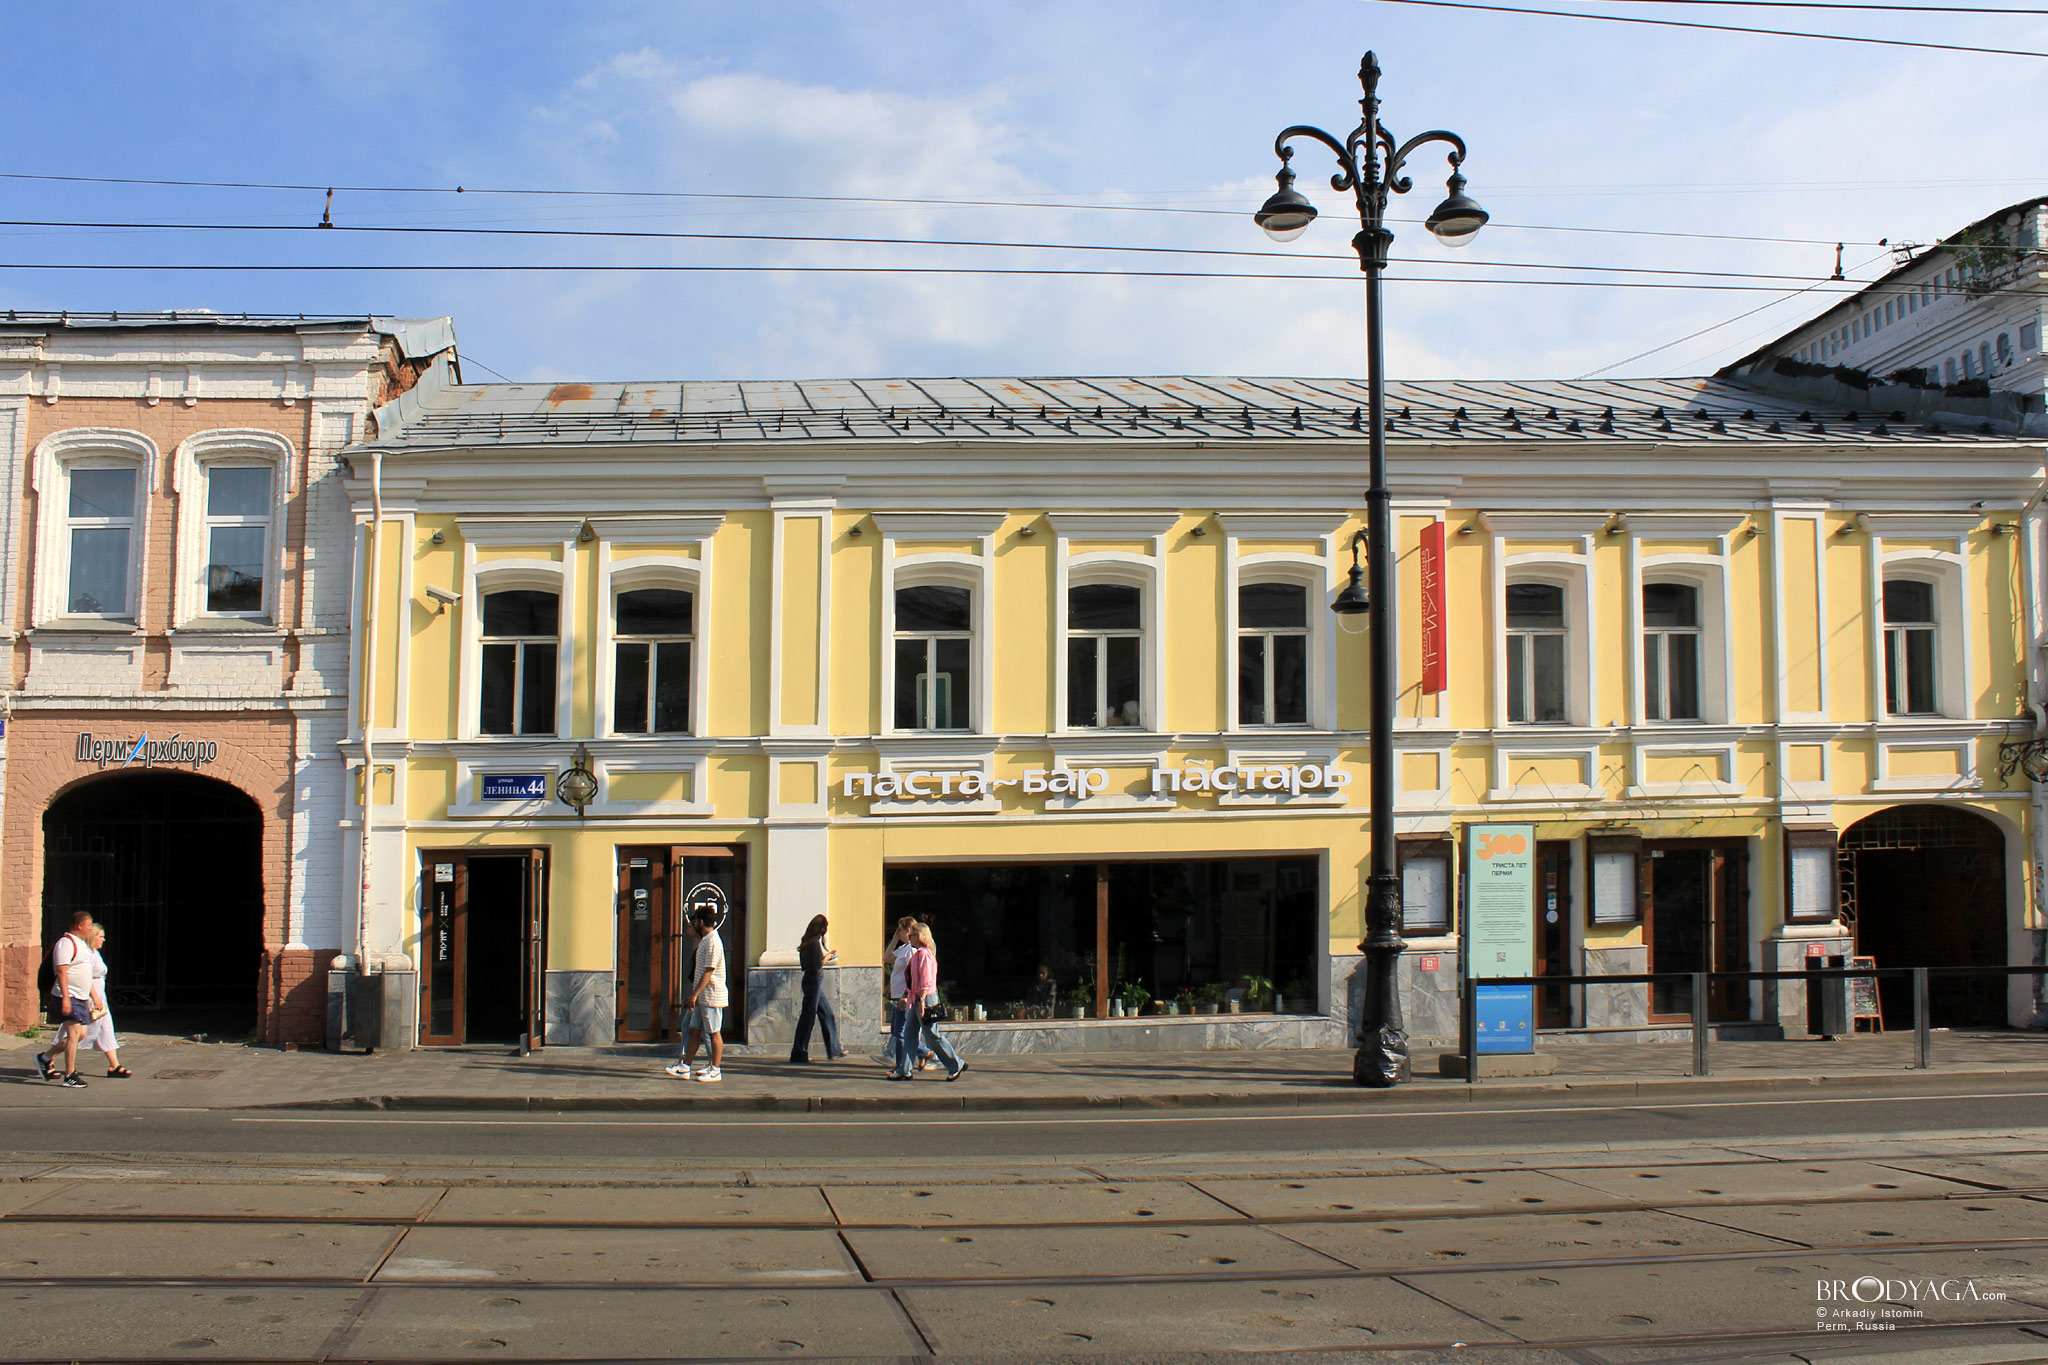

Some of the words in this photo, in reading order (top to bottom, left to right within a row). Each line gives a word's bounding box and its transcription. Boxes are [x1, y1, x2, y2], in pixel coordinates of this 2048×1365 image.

[1425, 548, 1438, 668] ТРИУМФ
[484, 786, 527, 795] ЛЕНИНА
[527, 779, 545, 795] 44
[1476, 833, 1527, 861] 300
